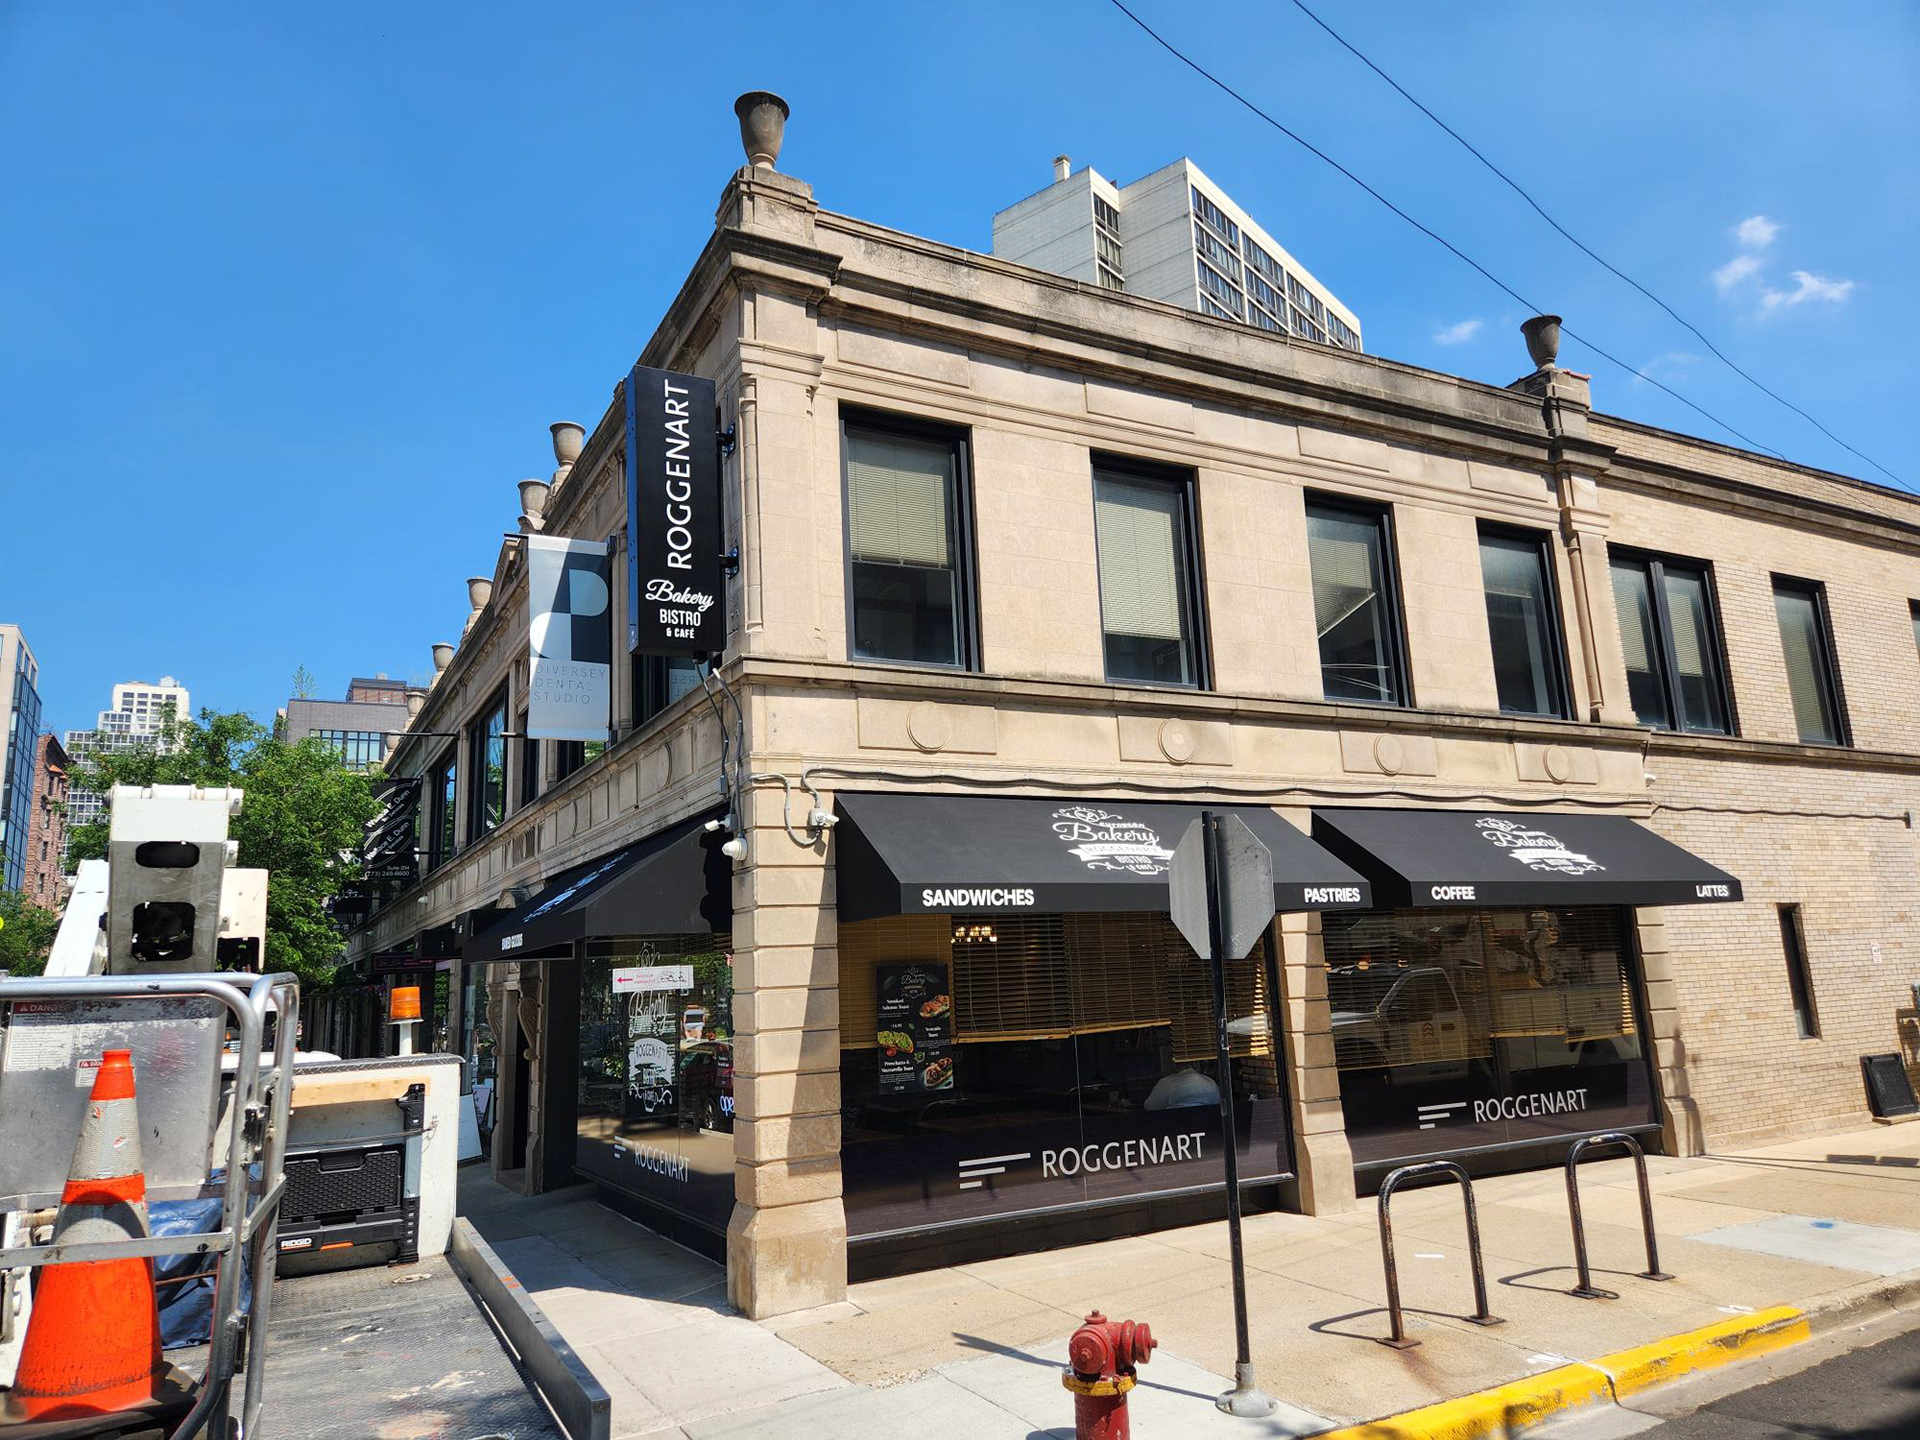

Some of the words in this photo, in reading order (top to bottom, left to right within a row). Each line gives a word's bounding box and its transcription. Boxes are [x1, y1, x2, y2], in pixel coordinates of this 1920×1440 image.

[664, 379, 692, 569] ROGGENART
[645, 579, 714, 611] Bakery
[659, 608, 701, 627] BISTRO
[666, 627, 672, 636] &
[674, 627, 695, 638] CAFÉ
[537, 664, 606, 678] DIVERSEY
[535, 678, 592, 691] DENTAL
[534, 691, 591, 704] STUDIO
[393, 789, 410, 804] Dunn
[365, 840, 389, 860] Wallace
[392, 822, 410, 836] Dunn
[1052, 822, 1160, 847] Bakery
[1482, 830, 1565, 851] Bakery
[1114, 855, 1153, 864] BISTRO
[922, 889, 1035, 907] SANDWICHES
[1304, 888, 1361, 902] PASTRIES
[1431, 886, 1476, 900] COFFEE
[1695, 884, 1729, 898] LATTES
[629, 990, 669, 1038] Bakery
[720, 1095, 735, 1115] ope
[1473, 1088, 1588, 1123] ROGGENART
[634, 1143, 691, 1183] ROGGENART
[1041, 1132, 1206, 1179] ROGGENART
[280, 1237, 312, 1248] RIDGID
